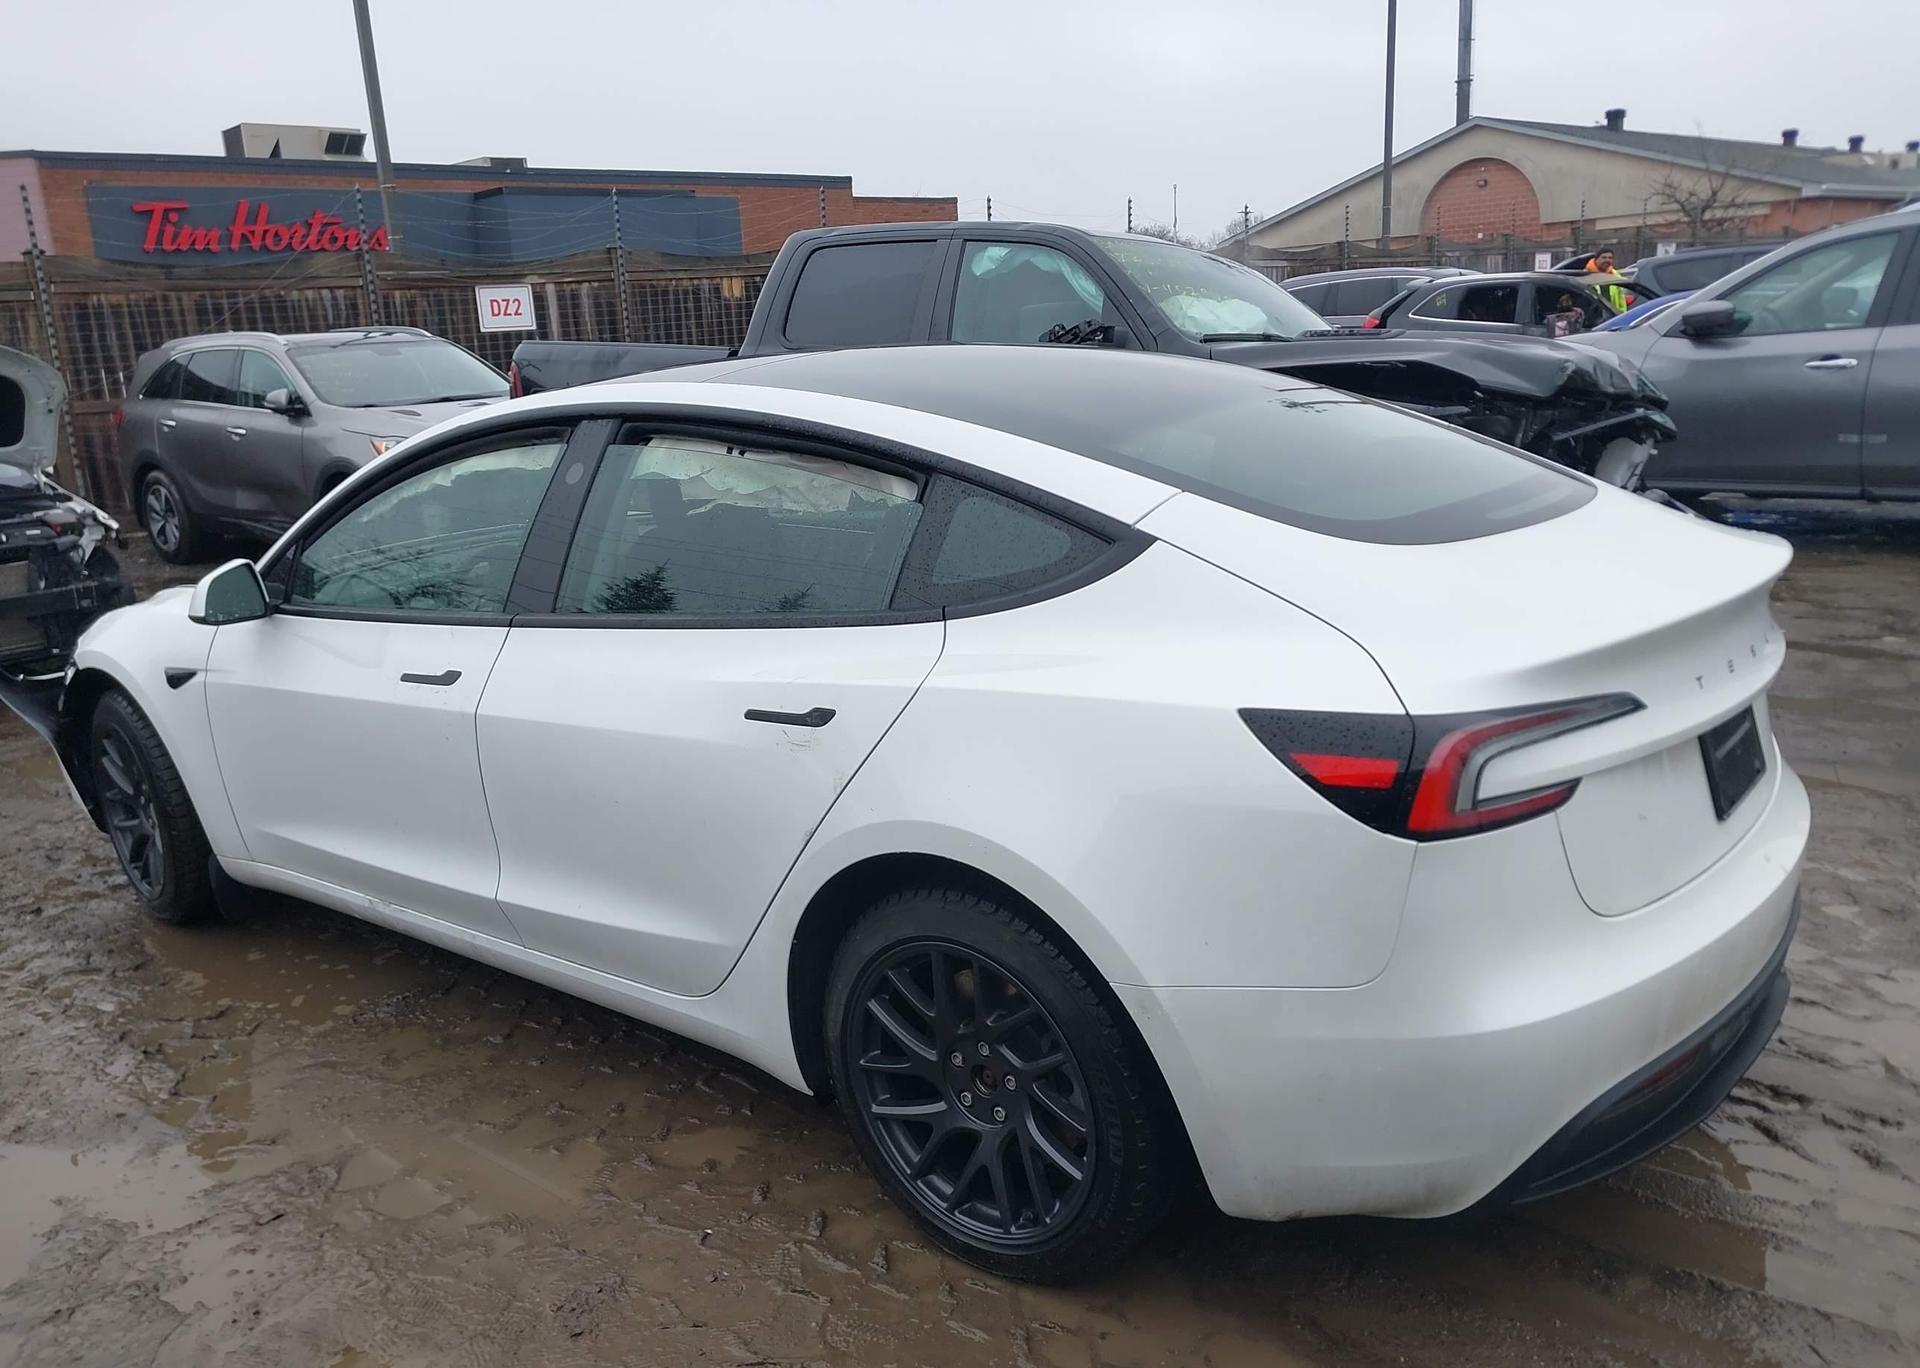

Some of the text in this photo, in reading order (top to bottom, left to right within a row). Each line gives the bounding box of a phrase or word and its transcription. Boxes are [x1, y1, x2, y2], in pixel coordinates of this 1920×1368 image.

[131, 199, 390, 252] Tim Hortons
[490, 298, 522, 317] DZ2
